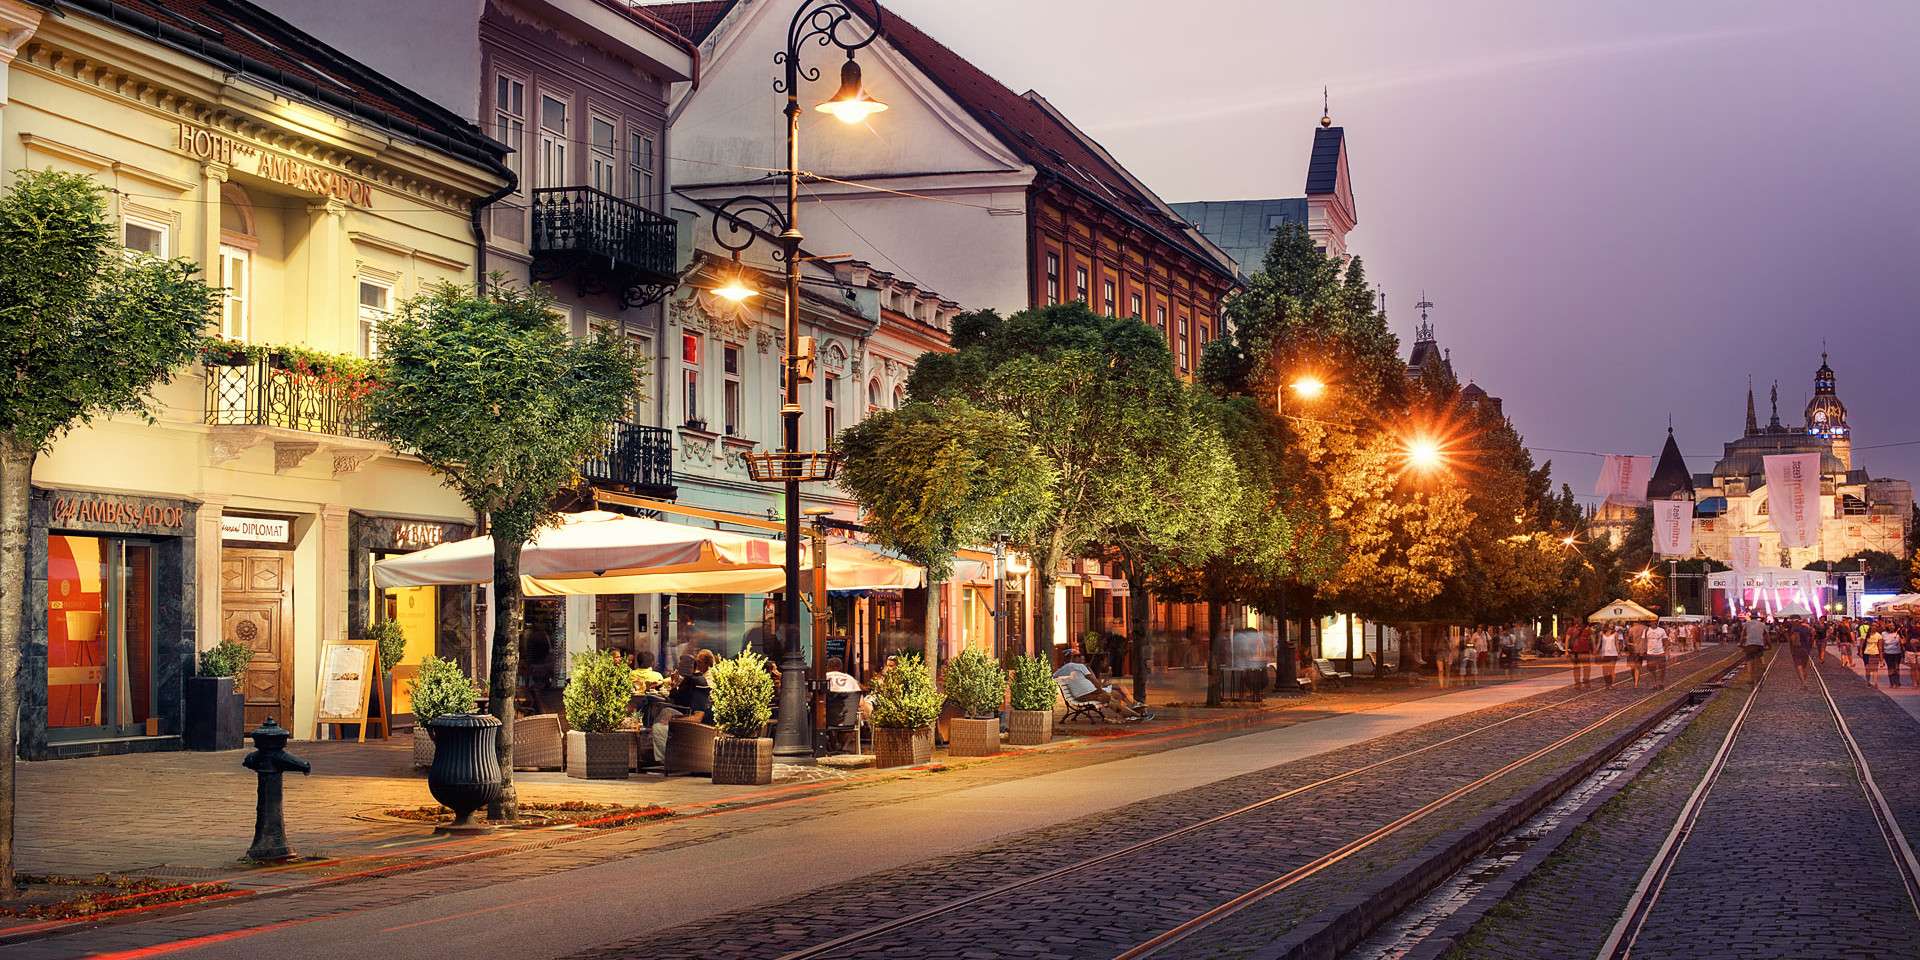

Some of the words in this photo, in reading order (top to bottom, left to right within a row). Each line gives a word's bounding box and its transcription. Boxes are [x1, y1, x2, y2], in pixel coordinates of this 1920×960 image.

[178, 123, 233, 165] HOTEL
[257, 150, 373, 209] AMBASSADOR
[80, 499, 184, 529] AMBASSADOR
[242, 522, 284, 537] DIPLOMAT
